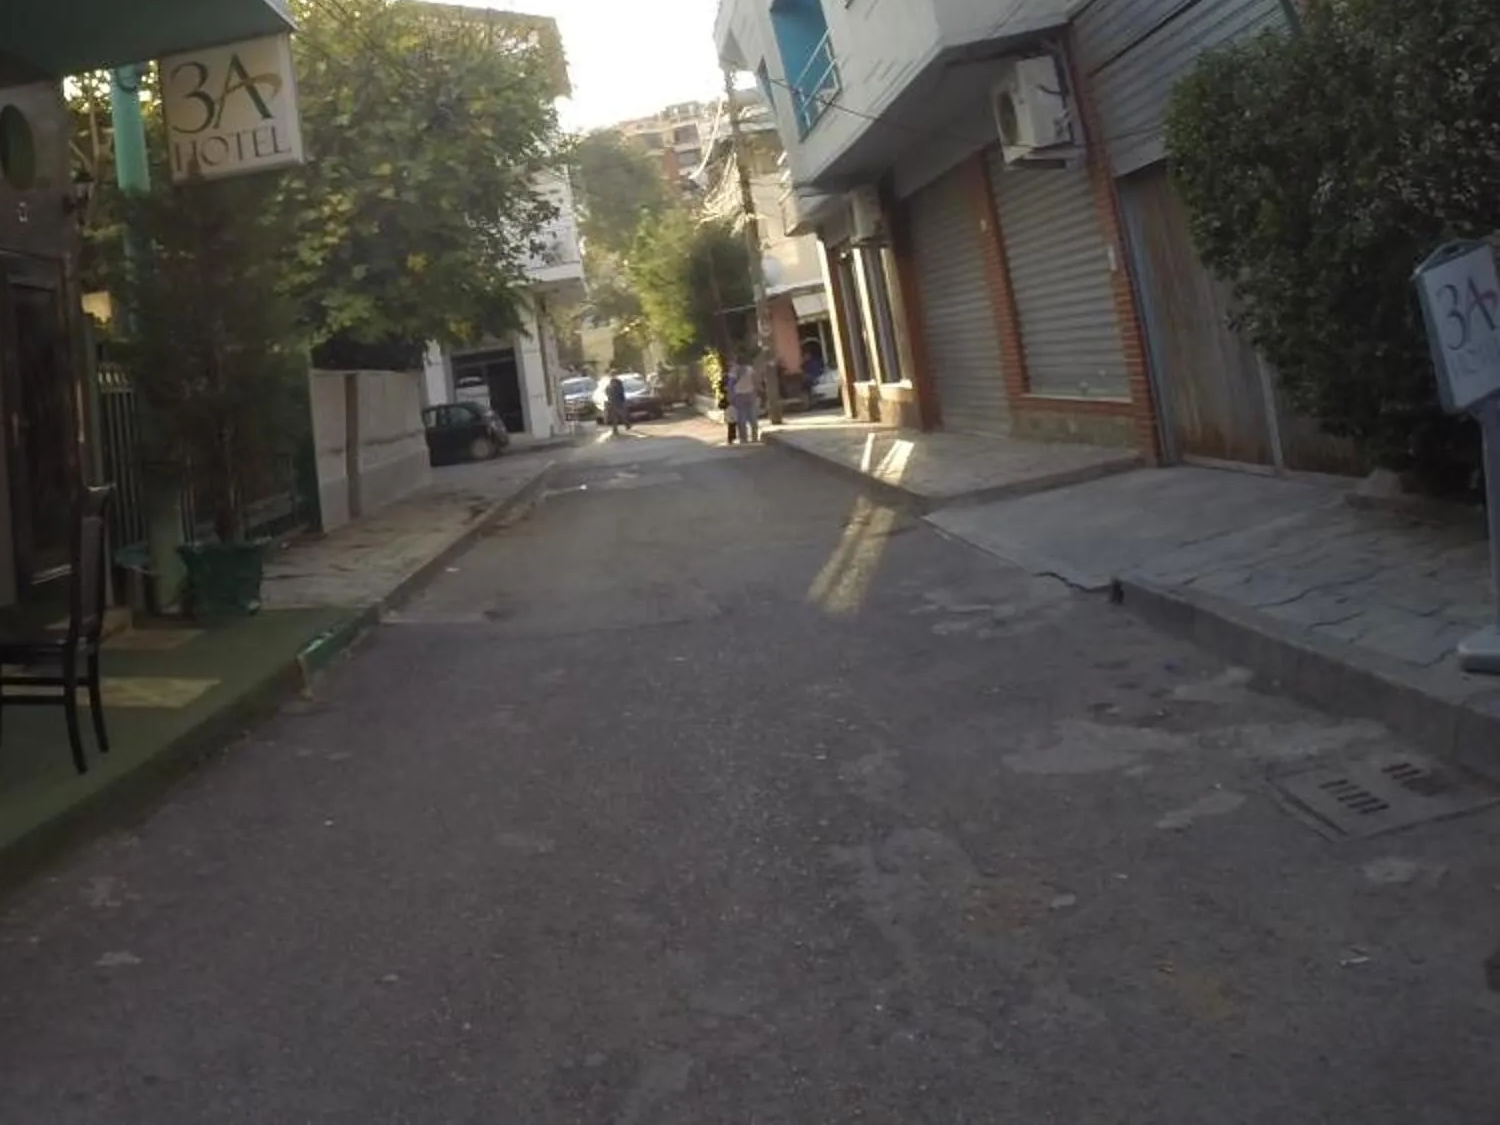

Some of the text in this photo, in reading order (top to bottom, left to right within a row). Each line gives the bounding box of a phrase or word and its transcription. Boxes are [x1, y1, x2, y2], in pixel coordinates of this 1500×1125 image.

[170, 51, 282, 134] 3A
[174, 126, 292, 172] HOTEL
[1436, 277, 1499, 351] 3A
